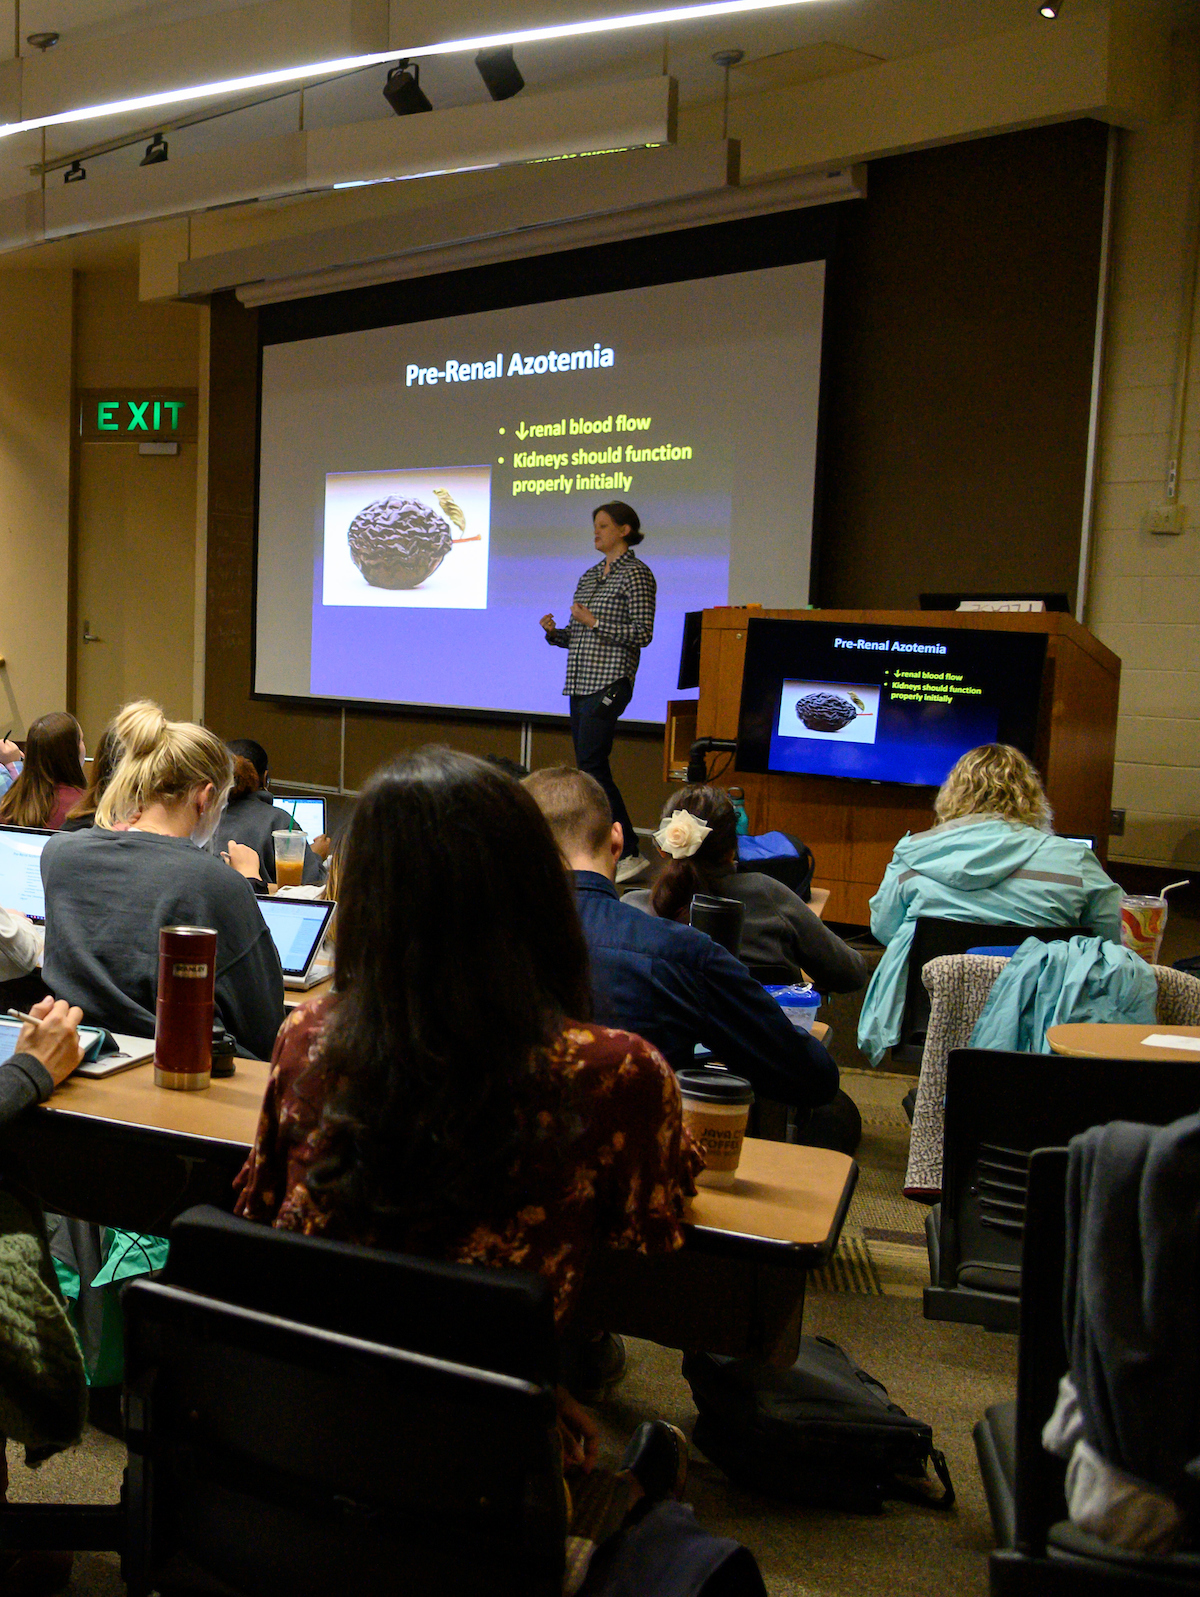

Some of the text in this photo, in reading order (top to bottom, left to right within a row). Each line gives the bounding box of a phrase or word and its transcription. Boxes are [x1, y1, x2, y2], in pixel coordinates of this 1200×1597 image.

[405, 343, 615, 387] Pre-Renal Azotemia
[97, 401, 186, 431] EXIT
[529, 414, 652, 438] renal blood flow
[513, 443, 693, 470] Kidneys should function
[512, 472, 633, 496] properly initially
[834, 637, 947, 655] Pre-Renal Azotemia
[891, 681, 982, 695] Kidneys should function
[901, 670, 964, 682] renal blood flow
[890, 692, 954, 704] properly initially
